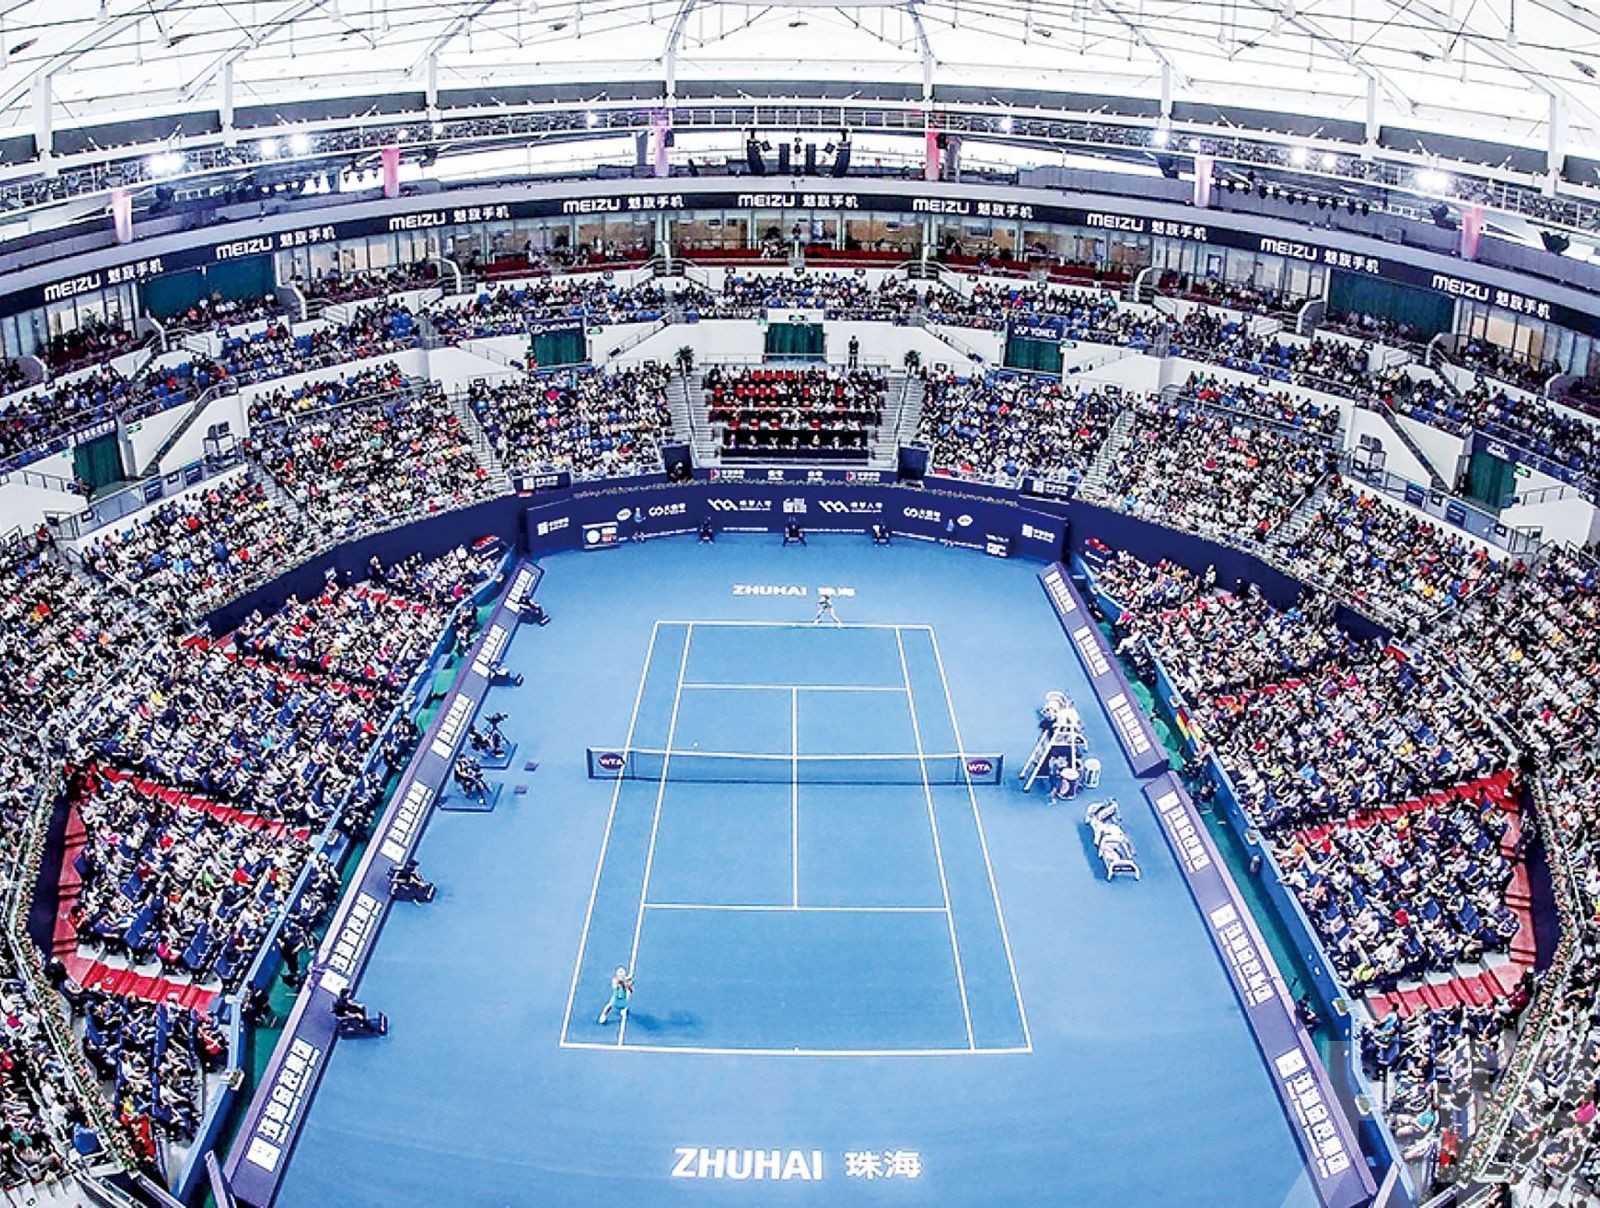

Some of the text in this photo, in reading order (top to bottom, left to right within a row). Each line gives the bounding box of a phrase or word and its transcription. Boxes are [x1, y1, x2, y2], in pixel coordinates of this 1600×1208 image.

[563, 198, 620, 214] MEIZU
[738, 194, 796, 208] MEIZU
[913, 198, 971, 214] MEIZU
[389, 212, 447, 231] MEIZU
[1086, 213, 1144, 232] MEIZU
[216, 237, 274, 260] MEIZU
[1260, 238, 1317, 261] MEIZU
[44, 272, 102, 300] MEIZU
[1432, 274, 1490, 302] MEIZU
[732, 584, 808, 596] ZHUHAI
[671, 1148, 922, 1180] ZHUHAI 珠海
